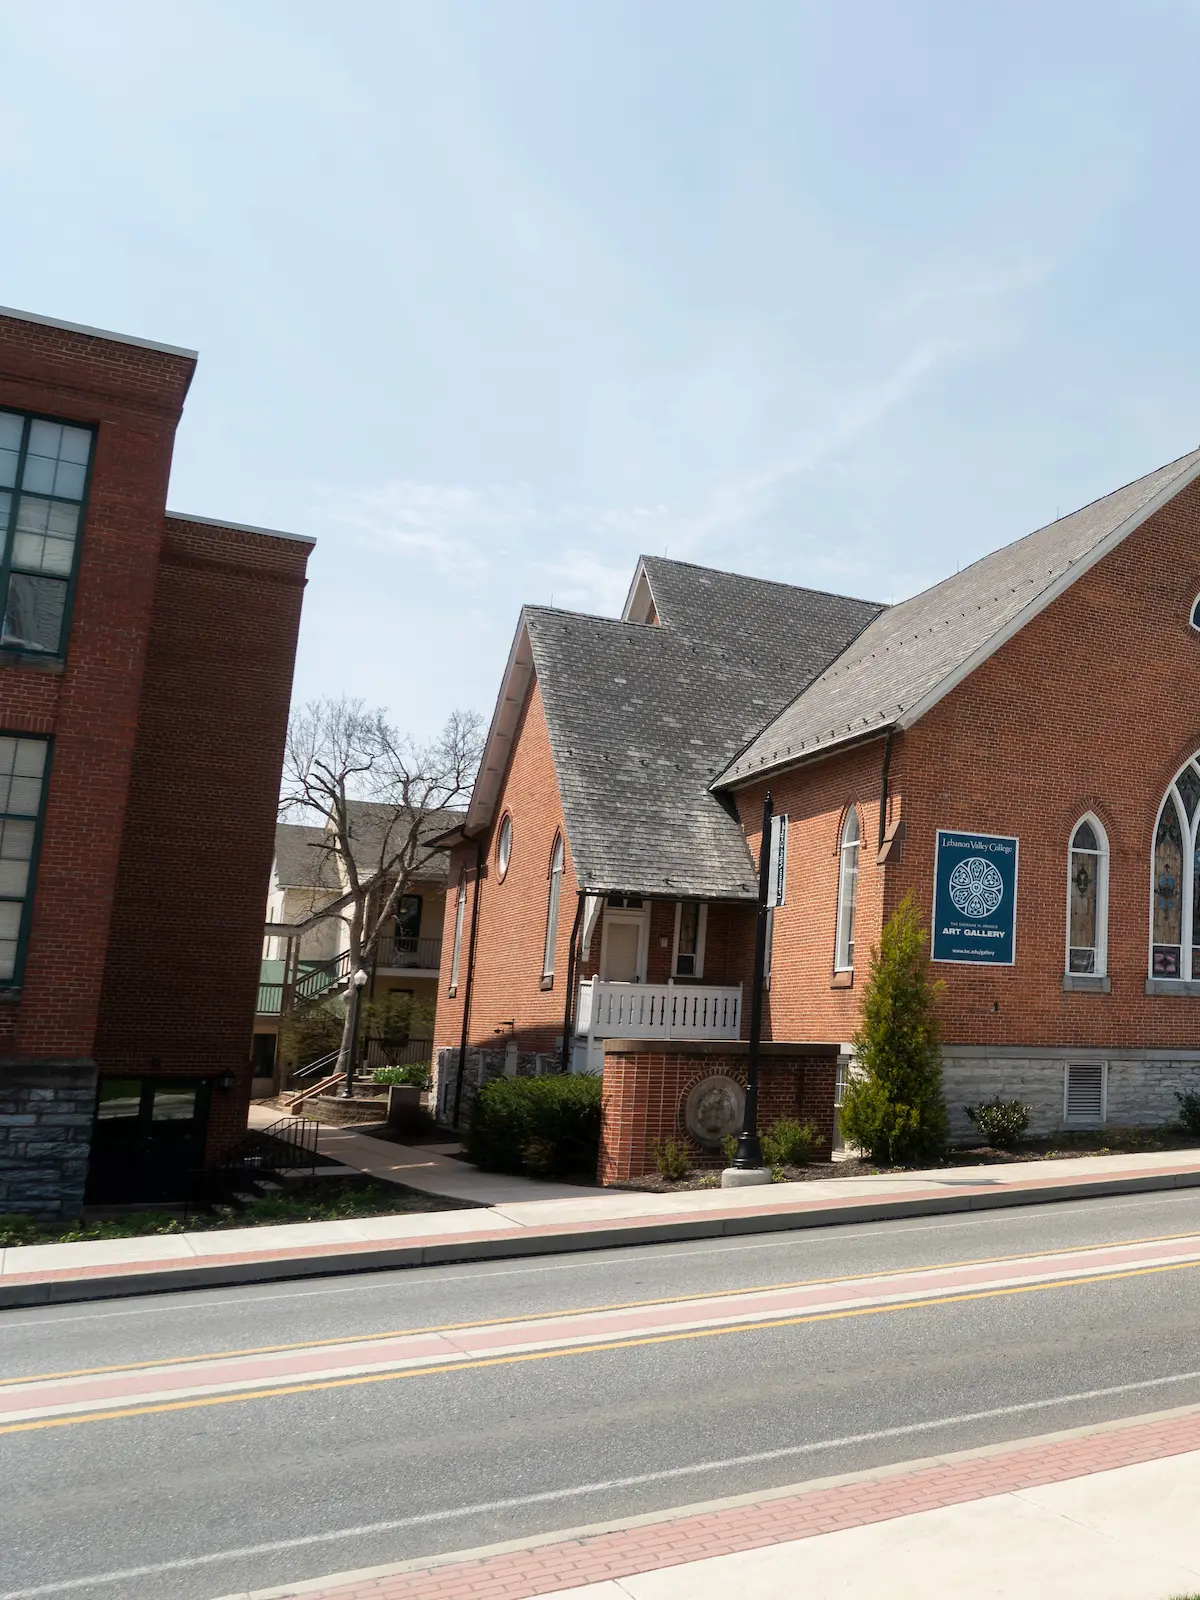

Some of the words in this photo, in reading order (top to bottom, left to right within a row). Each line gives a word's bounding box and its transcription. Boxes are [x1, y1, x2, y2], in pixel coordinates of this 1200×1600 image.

[942, 838, 970, 848] Lebanon
[970, 841, 989, 852] Valley
[989, 843, 1012, 854] College
[942, 927, 962, 936] ART
[963, 929, 1005, 938] GALLERY
